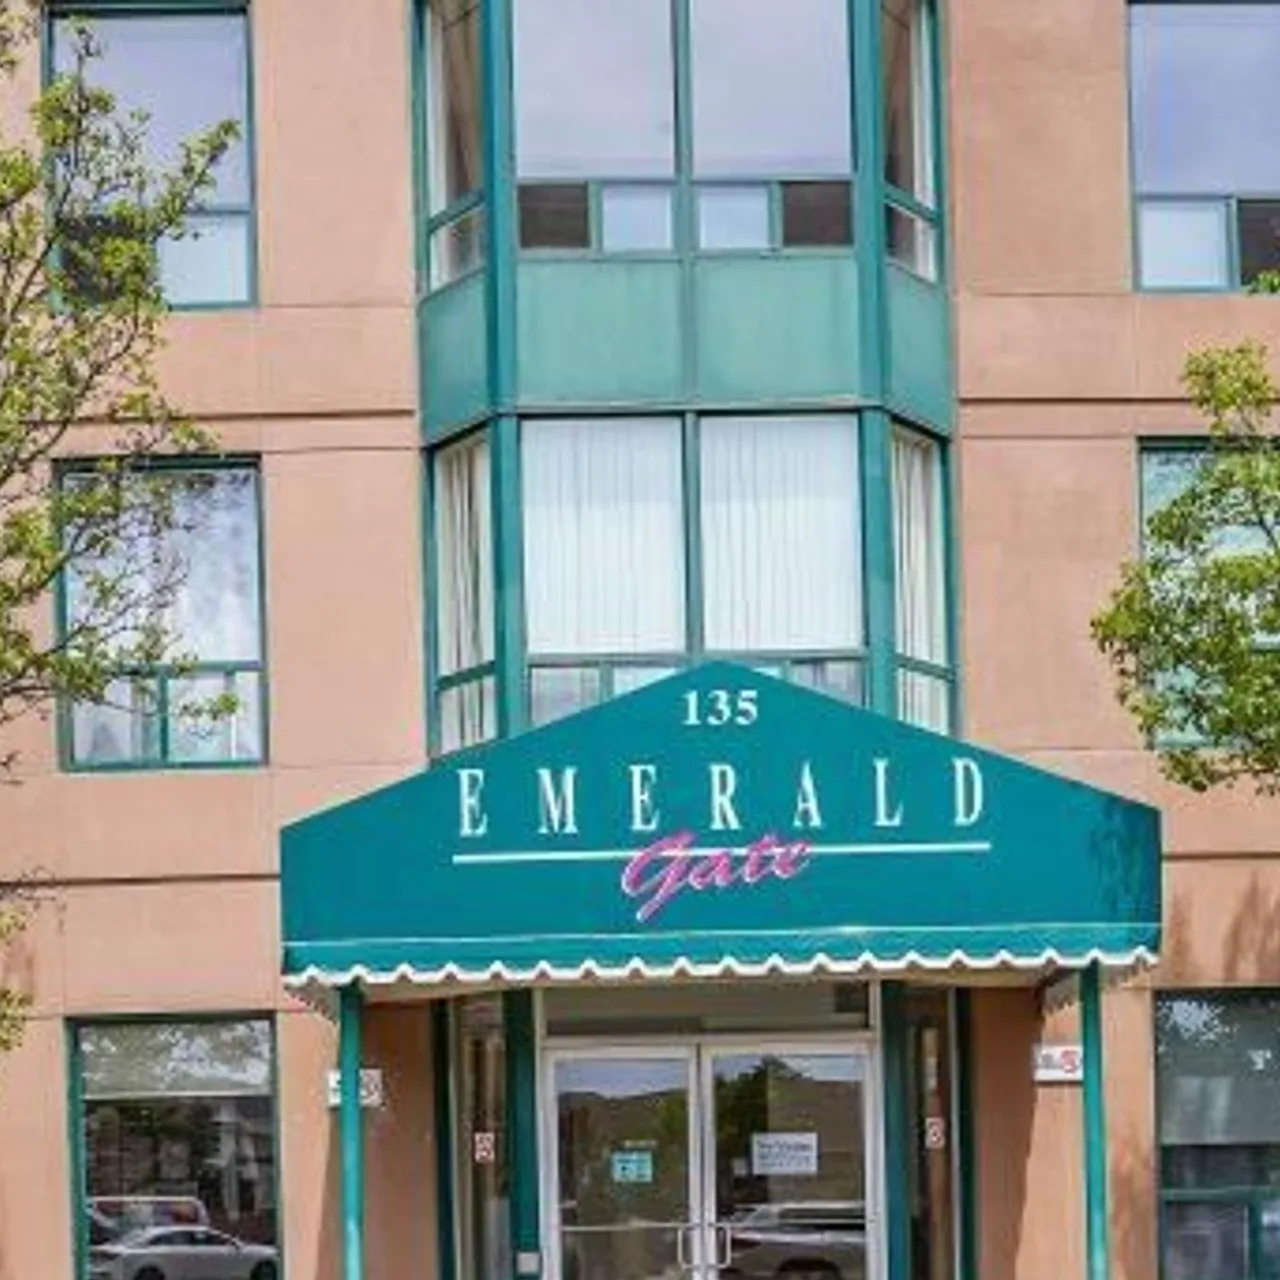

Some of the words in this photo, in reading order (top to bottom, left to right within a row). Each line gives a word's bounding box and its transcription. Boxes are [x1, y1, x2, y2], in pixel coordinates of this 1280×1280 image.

[682, 690, 758, 725] 135
[457, 758, 984, 838] EMERALD
[621, 831, 811, 922] Gate
